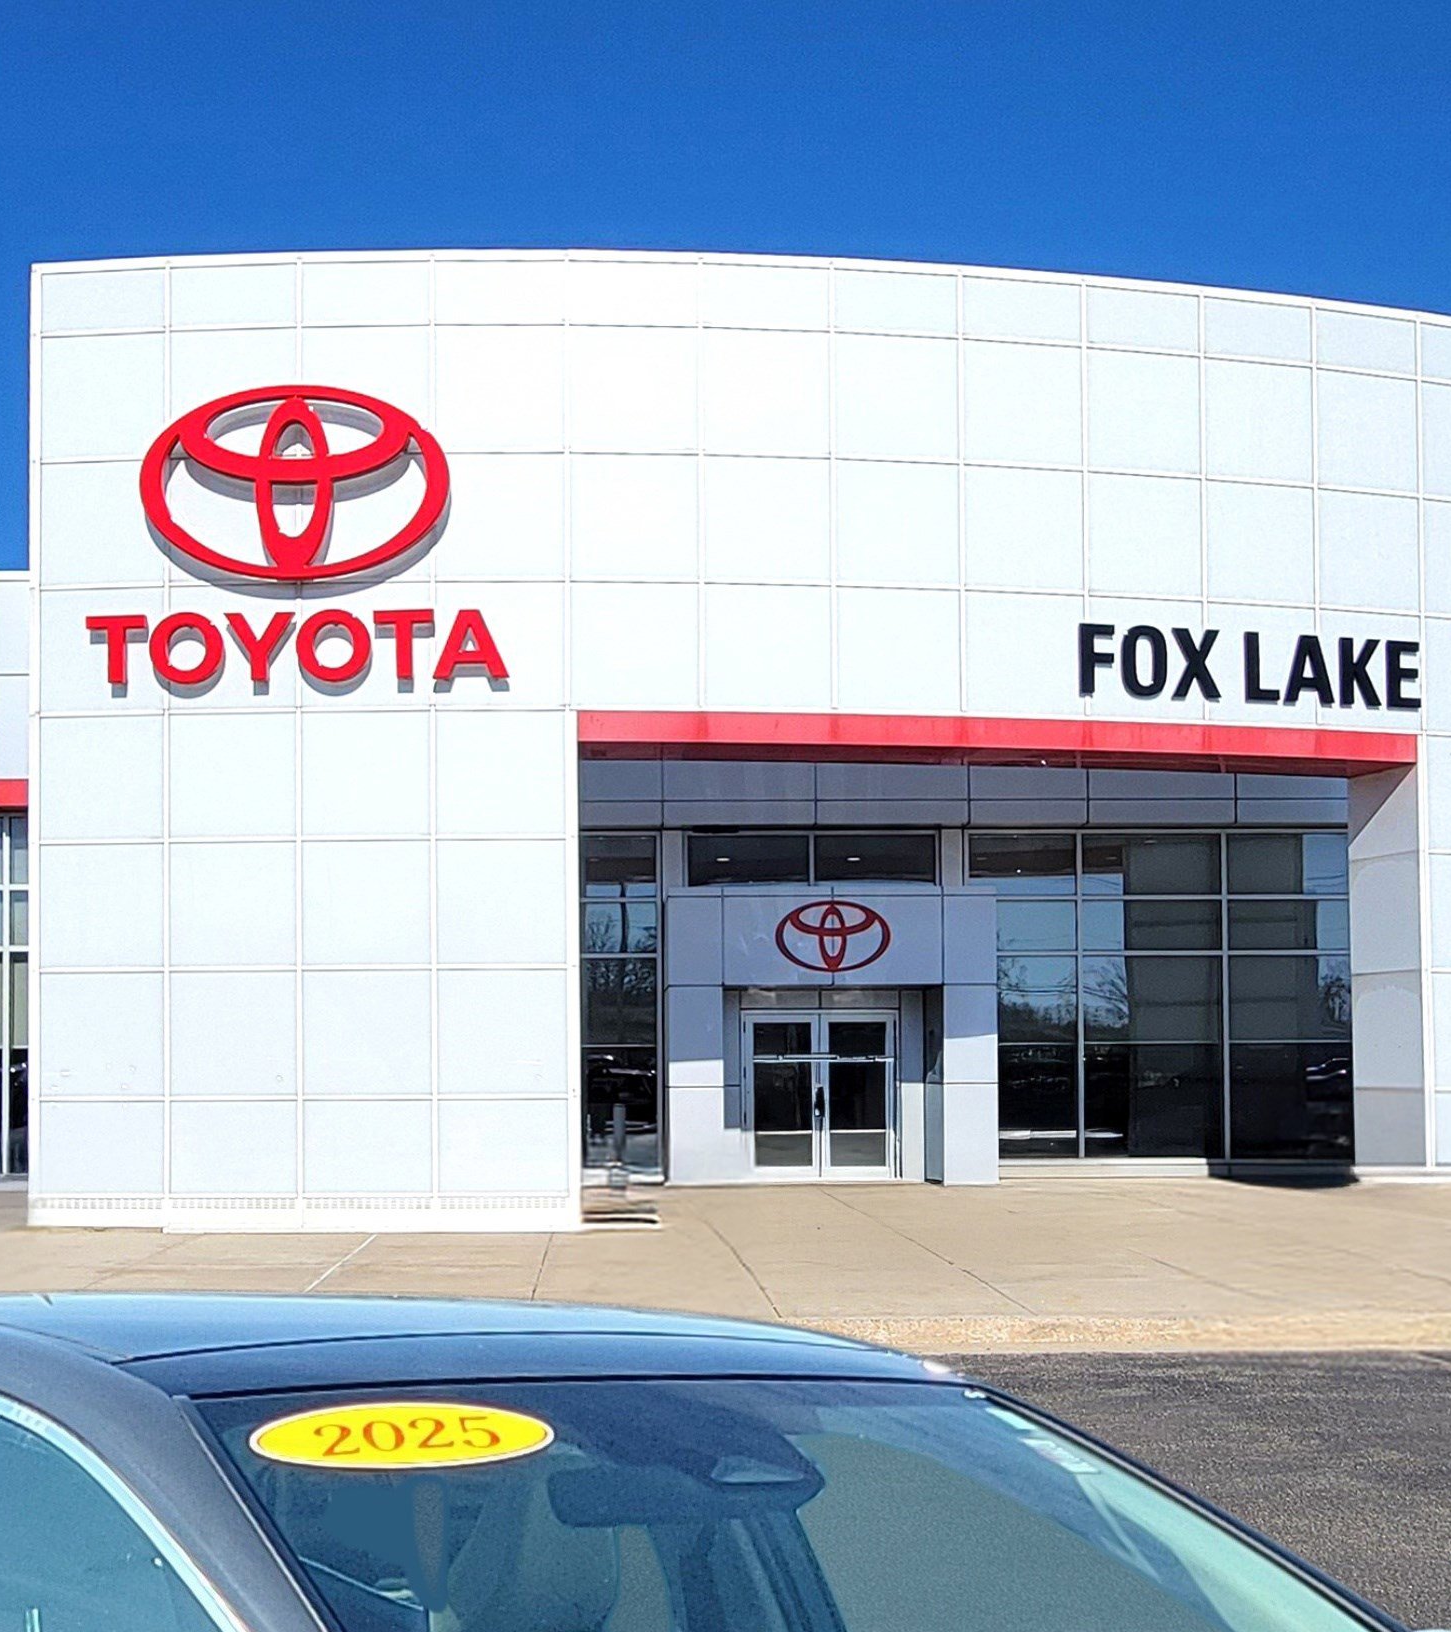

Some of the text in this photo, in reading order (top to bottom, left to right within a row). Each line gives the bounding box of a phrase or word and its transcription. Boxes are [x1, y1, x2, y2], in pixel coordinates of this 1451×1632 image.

[86, 608, 510, 696] TOYOTA
[1077, 623, 1422, 710] FOX LAKE
[313, 1415, 501, 1457] 2025
